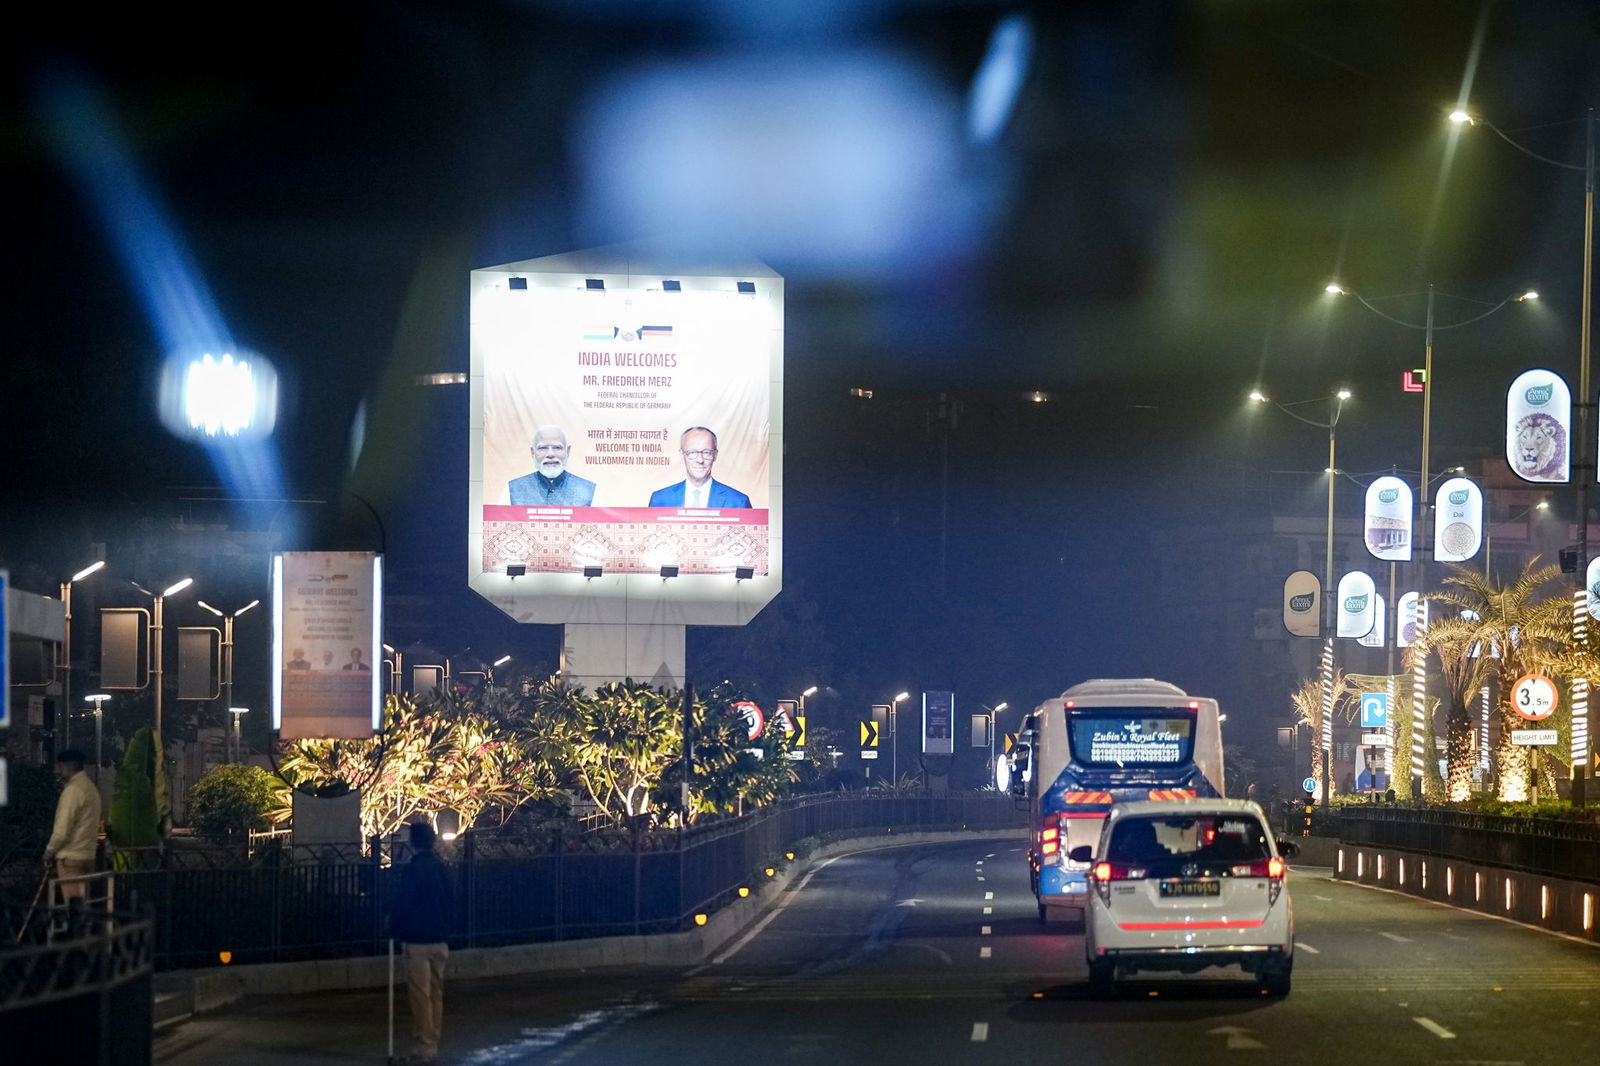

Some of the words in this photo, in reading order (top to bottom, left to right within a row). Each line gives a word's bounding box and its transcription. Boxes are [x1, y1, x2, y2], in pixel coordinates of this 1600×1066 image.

[578, 352, 611, 366] INDIA
[615, 353, 677, 367] WELCOMES
[583, 375, 600, 386] MR.
[602, 376, 646, 386] FRIEDRICH
[648, 376, 672, 387] MERZ
[587, 429, 604, 440] भारत
[613, 430, 638, 440] आपका
[639, 430, 662, 440] स्वागत
[663, 428, 668, 440] है
[596, 443, 629, 453] WELCOME
[631, 443, 640, 453] TO
[642, 443, 662, 453] INDIA
[585, 456, 634, 465] WILLKOMMEN
[636, 456, 644, 465] IN
[646, 456, 670, 466] INDIEN
[1092, 731, 1128, 741] Zubin's
[1129, 732, 1157, 744] Royal
[1157, 731, 1180, 741] Fleet
